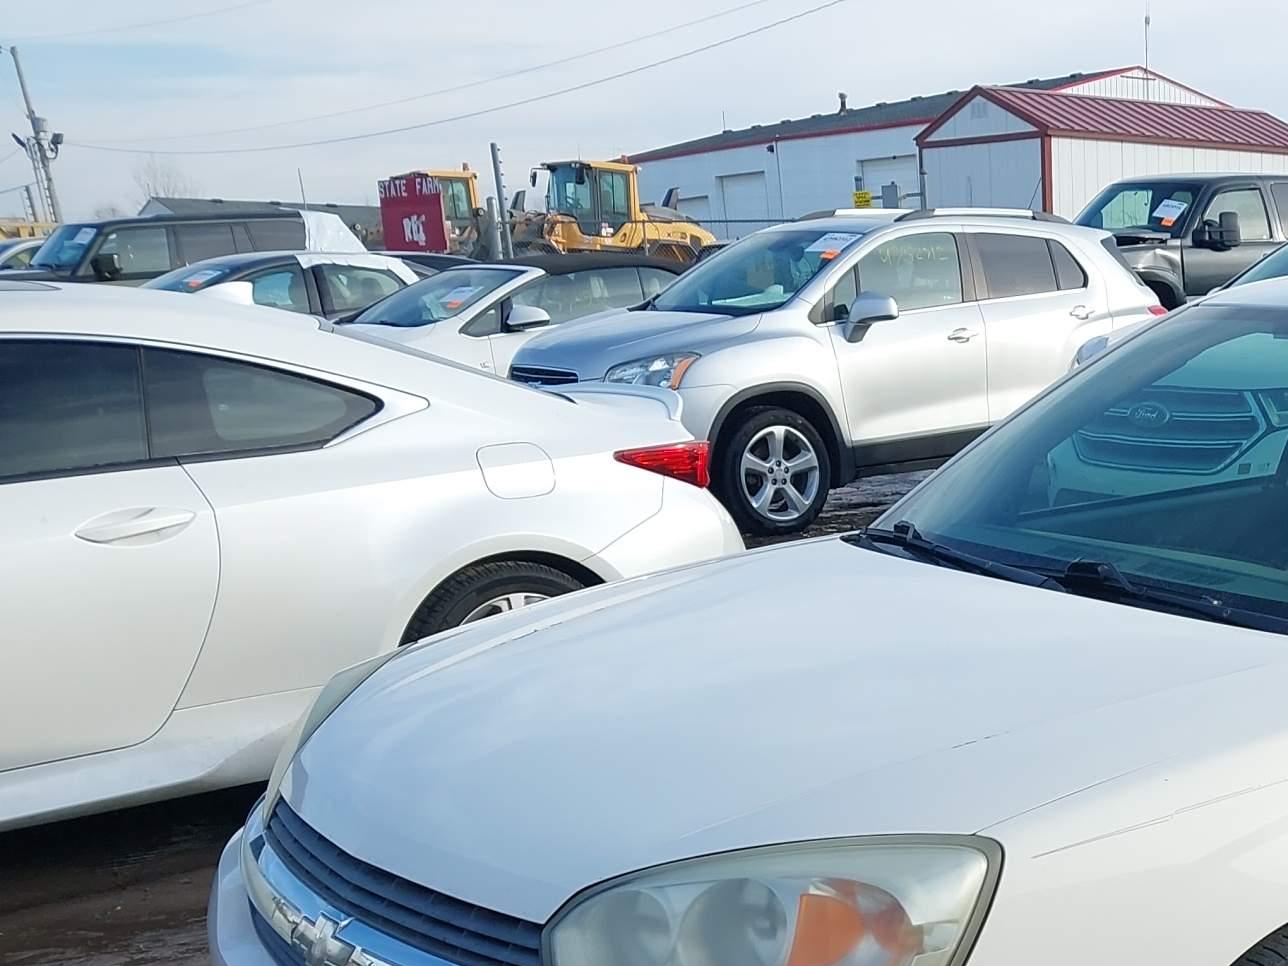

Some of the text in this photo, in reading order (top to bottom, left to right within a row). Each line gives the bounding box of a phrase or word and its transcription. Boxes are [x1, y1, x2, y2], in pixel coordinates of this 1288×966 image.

[378, 177, 442, 198] STATE FARM
[1134, 407, 1159, 419] Ford
